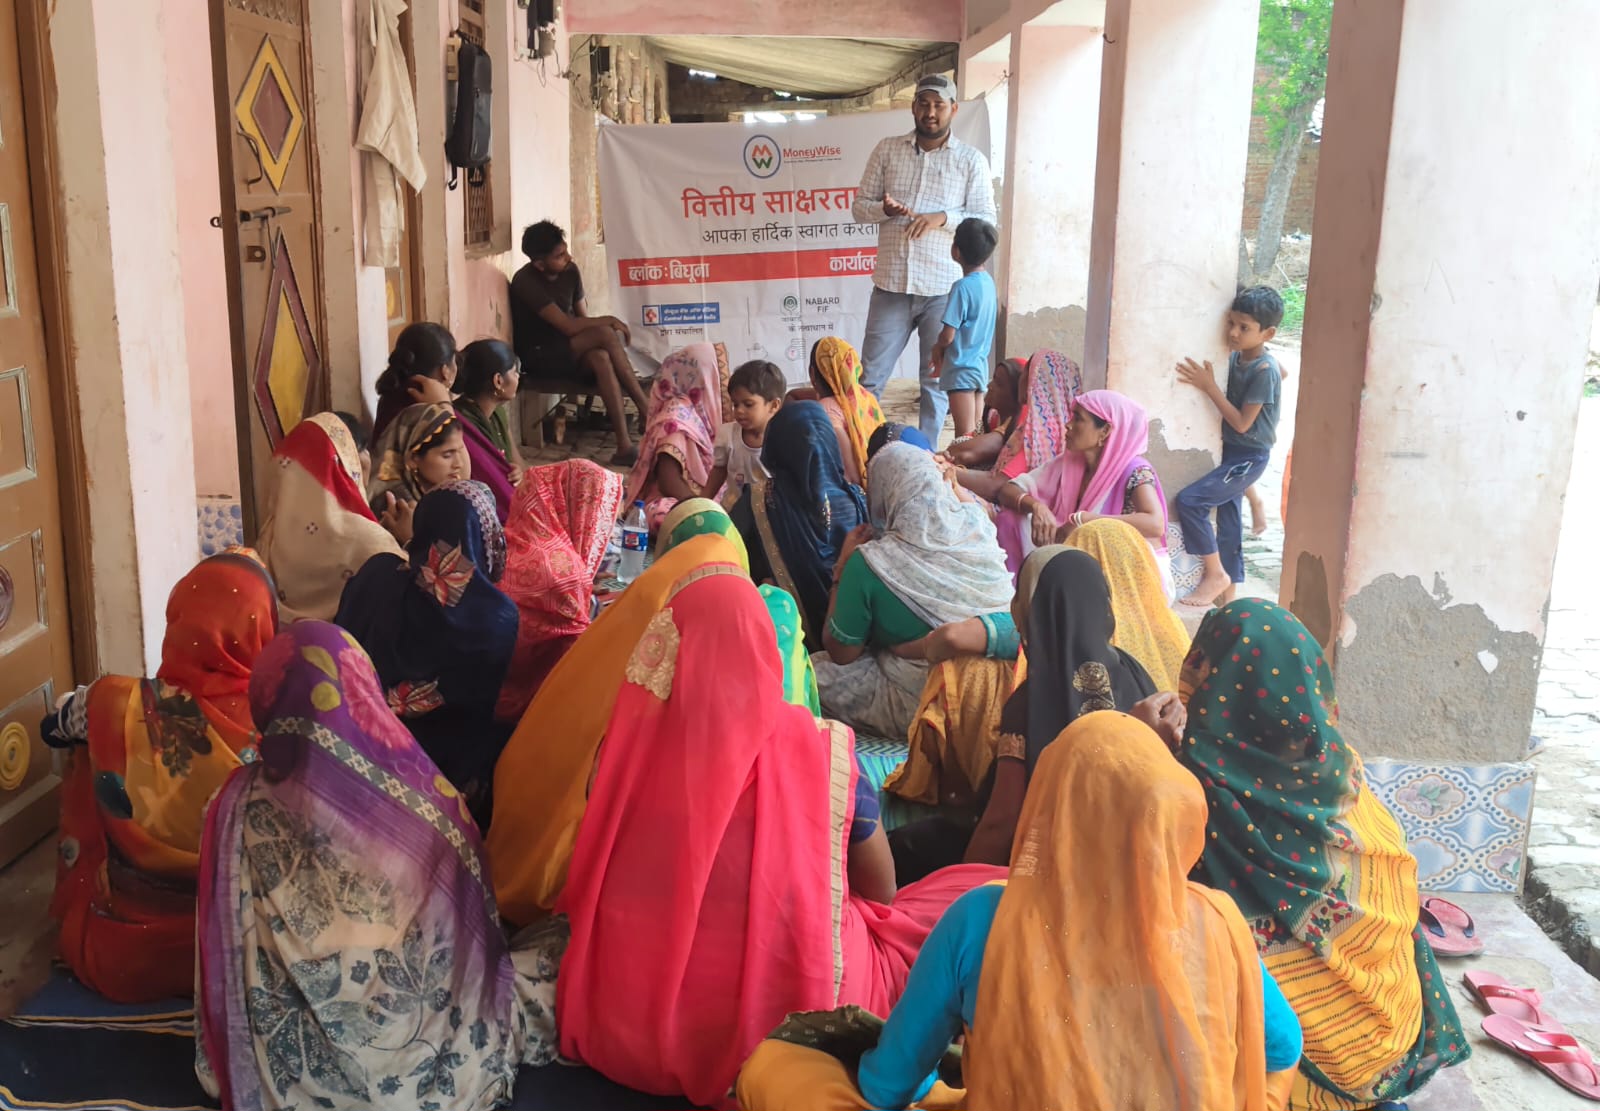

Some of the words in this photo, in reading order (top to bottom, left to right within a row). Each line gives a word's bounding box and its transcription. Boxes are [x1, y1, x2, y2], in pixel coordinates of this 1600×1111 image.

[783, 145, 841, 158] MoneyWise
[681, 186, 756, 218] वित्तीय
[702, 229, 747, 244] आपका
[750, 222, 793, 243] हार्दिक
[797, 224, 839, 239] स्वागत
[829, 251, 877, 271] कार्याल
[805, 297, 840, 305] NABARD
